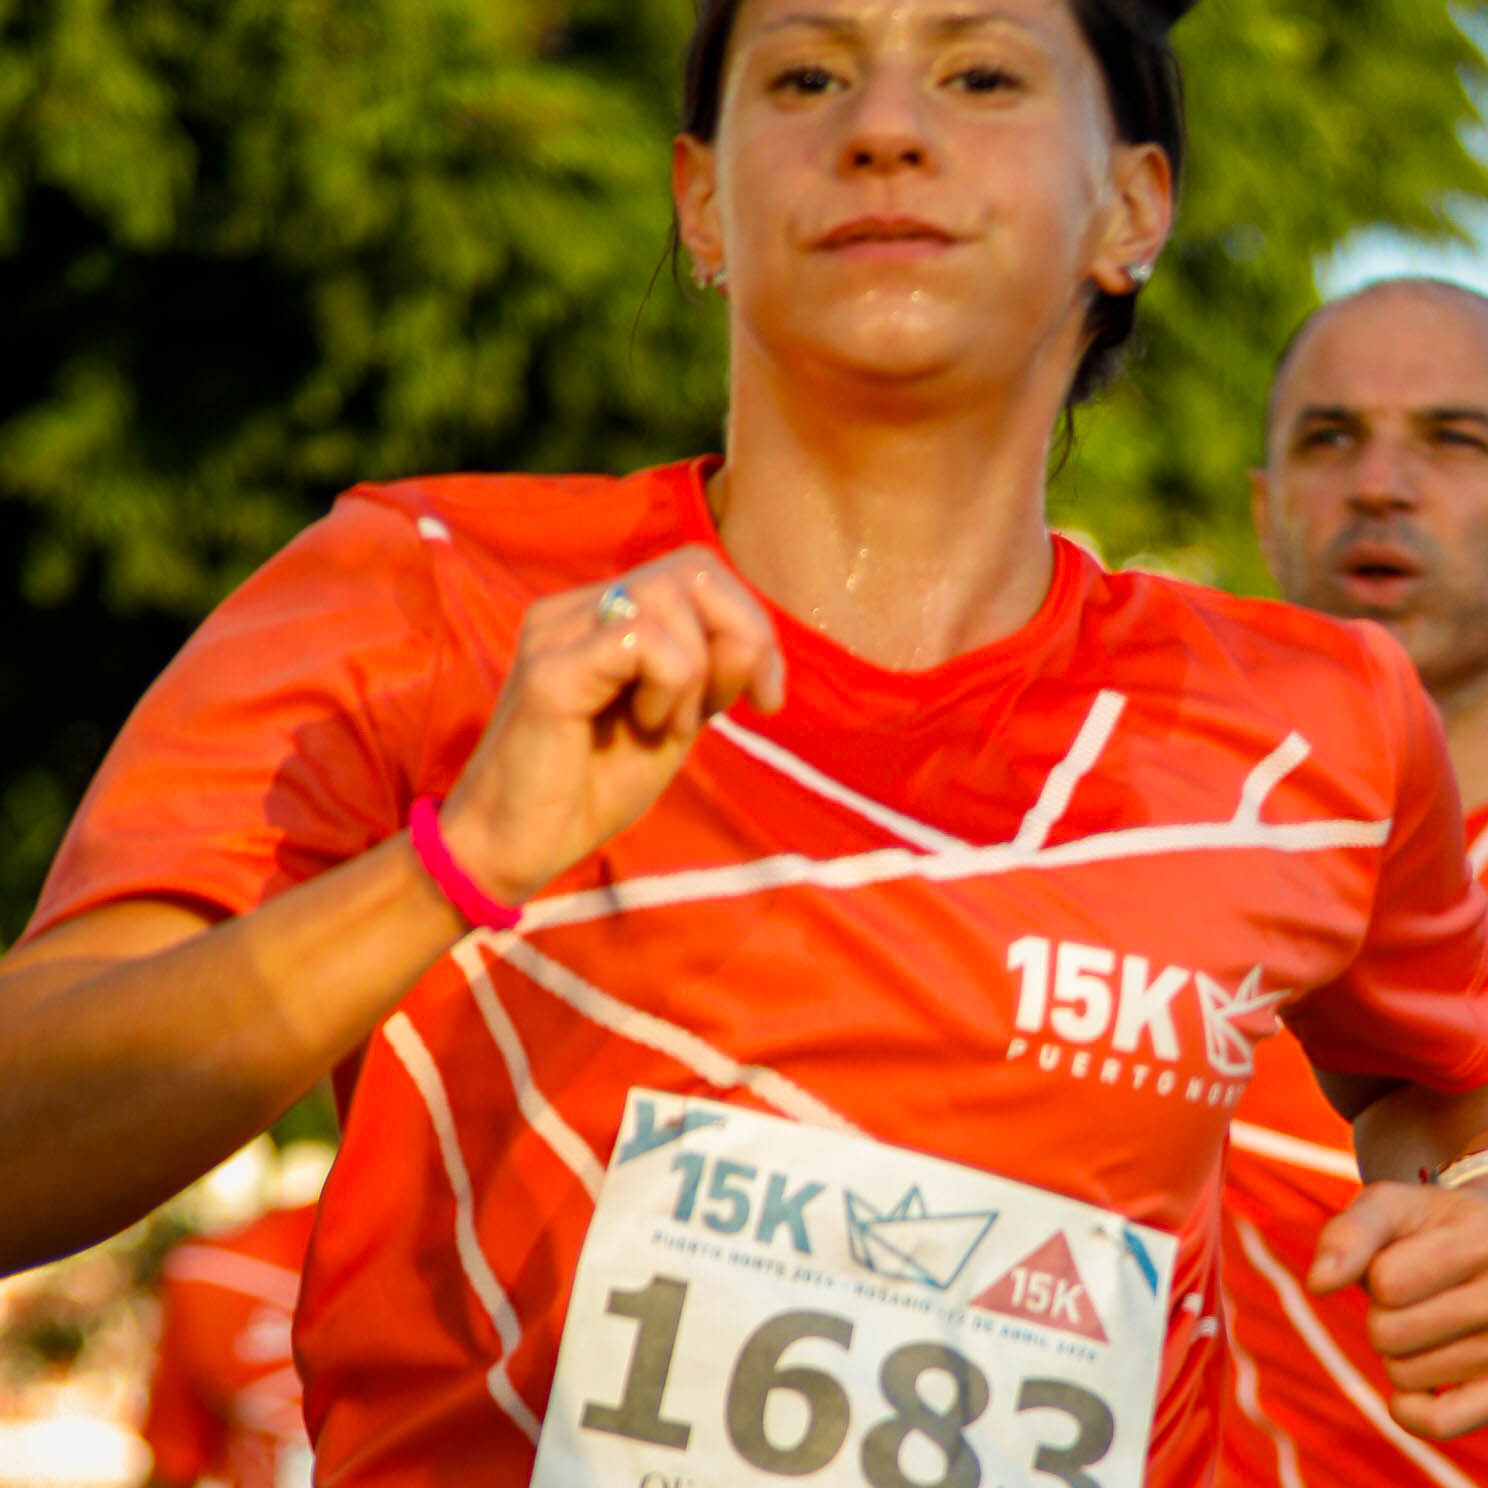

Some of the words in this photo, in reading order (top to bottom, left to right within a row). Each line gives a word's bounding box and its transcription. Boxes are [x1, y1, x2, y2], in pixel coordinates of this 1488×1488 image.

[1007, 936, 1189, 1060] 15K
[1007, 1038, 1176, 1095] PUERTO
[671, 1153, 826, 1254] 15K
[1010, 1268, 1083, 1323] 15K
